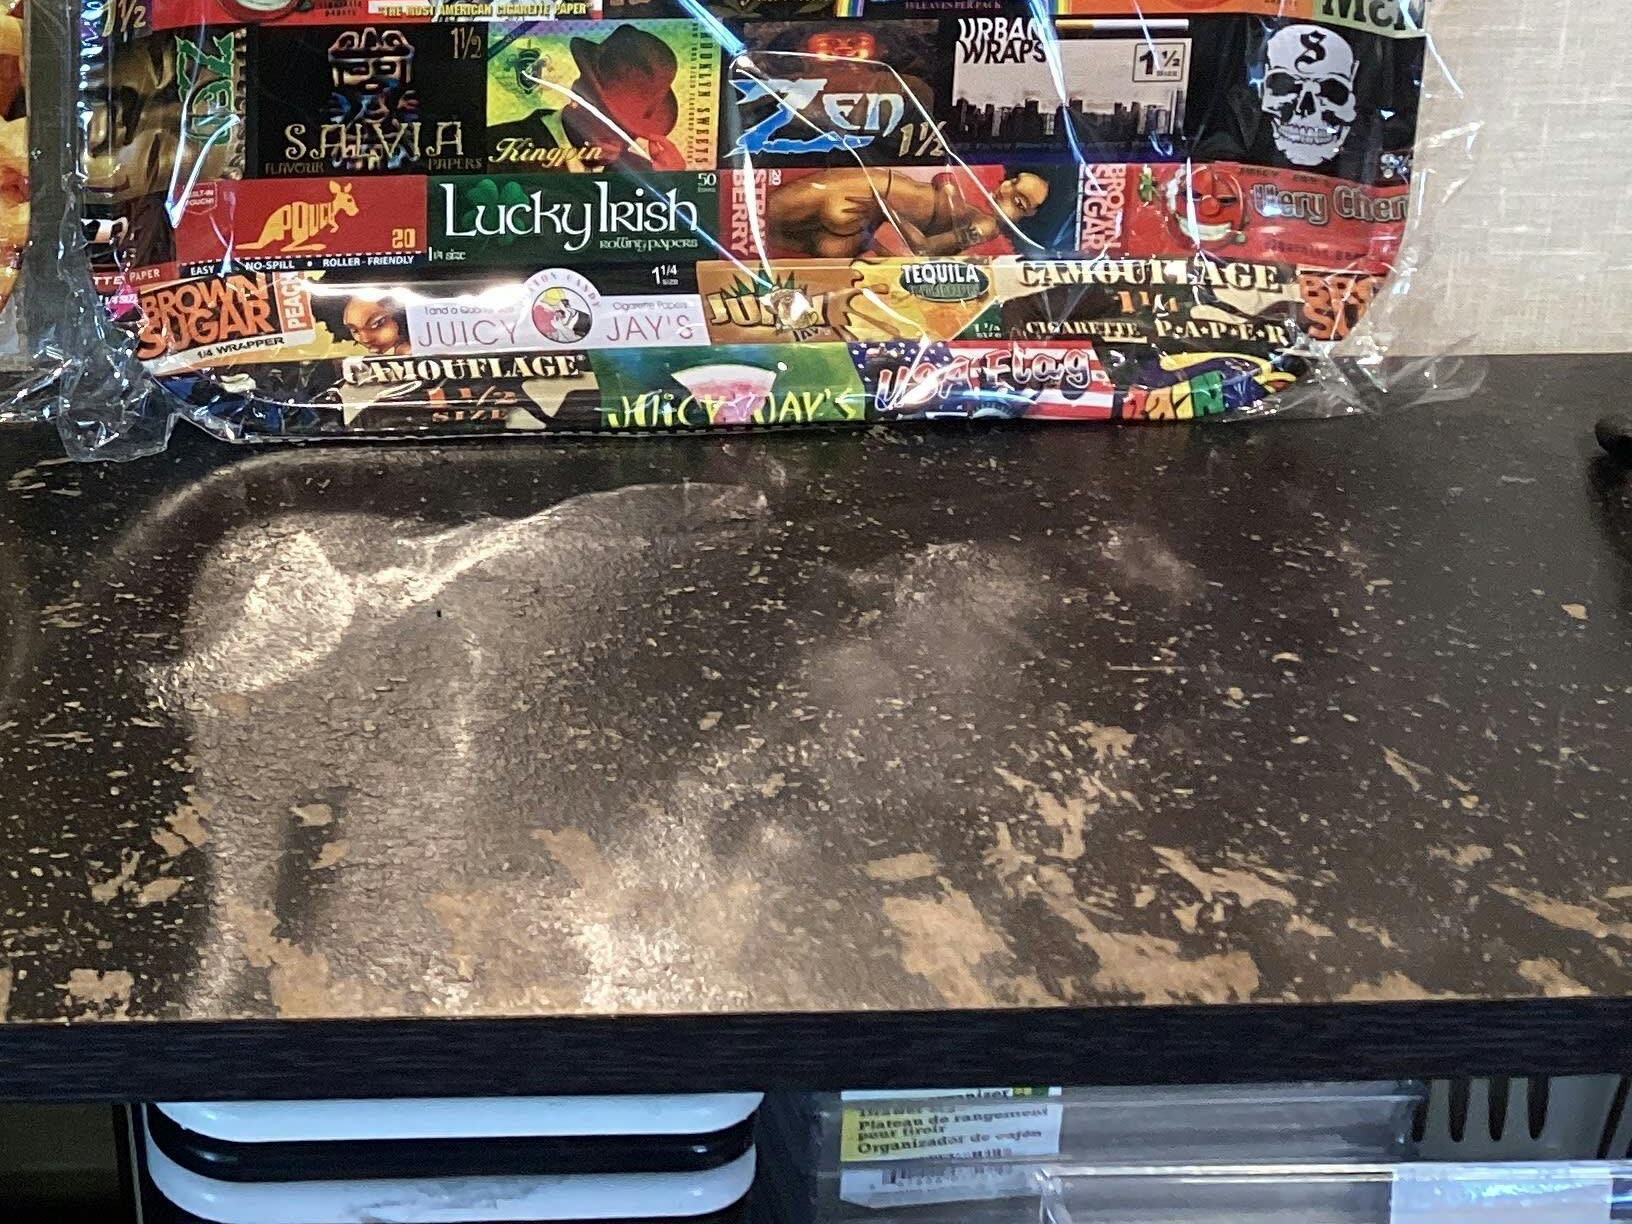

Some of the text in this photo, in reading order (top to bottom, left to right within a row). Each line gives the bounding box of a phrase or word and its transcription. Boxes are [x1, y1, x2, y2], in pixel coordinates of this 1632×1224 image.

[439, 2, 493, 17] AMERICAN
[496, 1, 551, 17] CIGARETTE
[957, 16, 1045, 45] URBAN
[957, 39, 1047, 65] WRAPS
[488, 137, 604, 167] Kingpin
[697, 172, 717, 186] 50
[731, 168, 749, 257] BERRY
[190, 265, 216, 277] EASY
[900, 262, 982, 287] TEQUILA
[144, 271, 271, 321] BROWN
[136, 301, 277, 361] SUGAR
[417, 318, 518, 349] JUICY
[606, 313, 695, 343] JAY'S
[215, 335, 286, 358] WRAPPER
[984, 340, 1093, 390] Flag
[928, 1112, 951, 1126] de
[856, 1136, 964, 1155] Organizador
[969, 1132, 987, 1144] de
